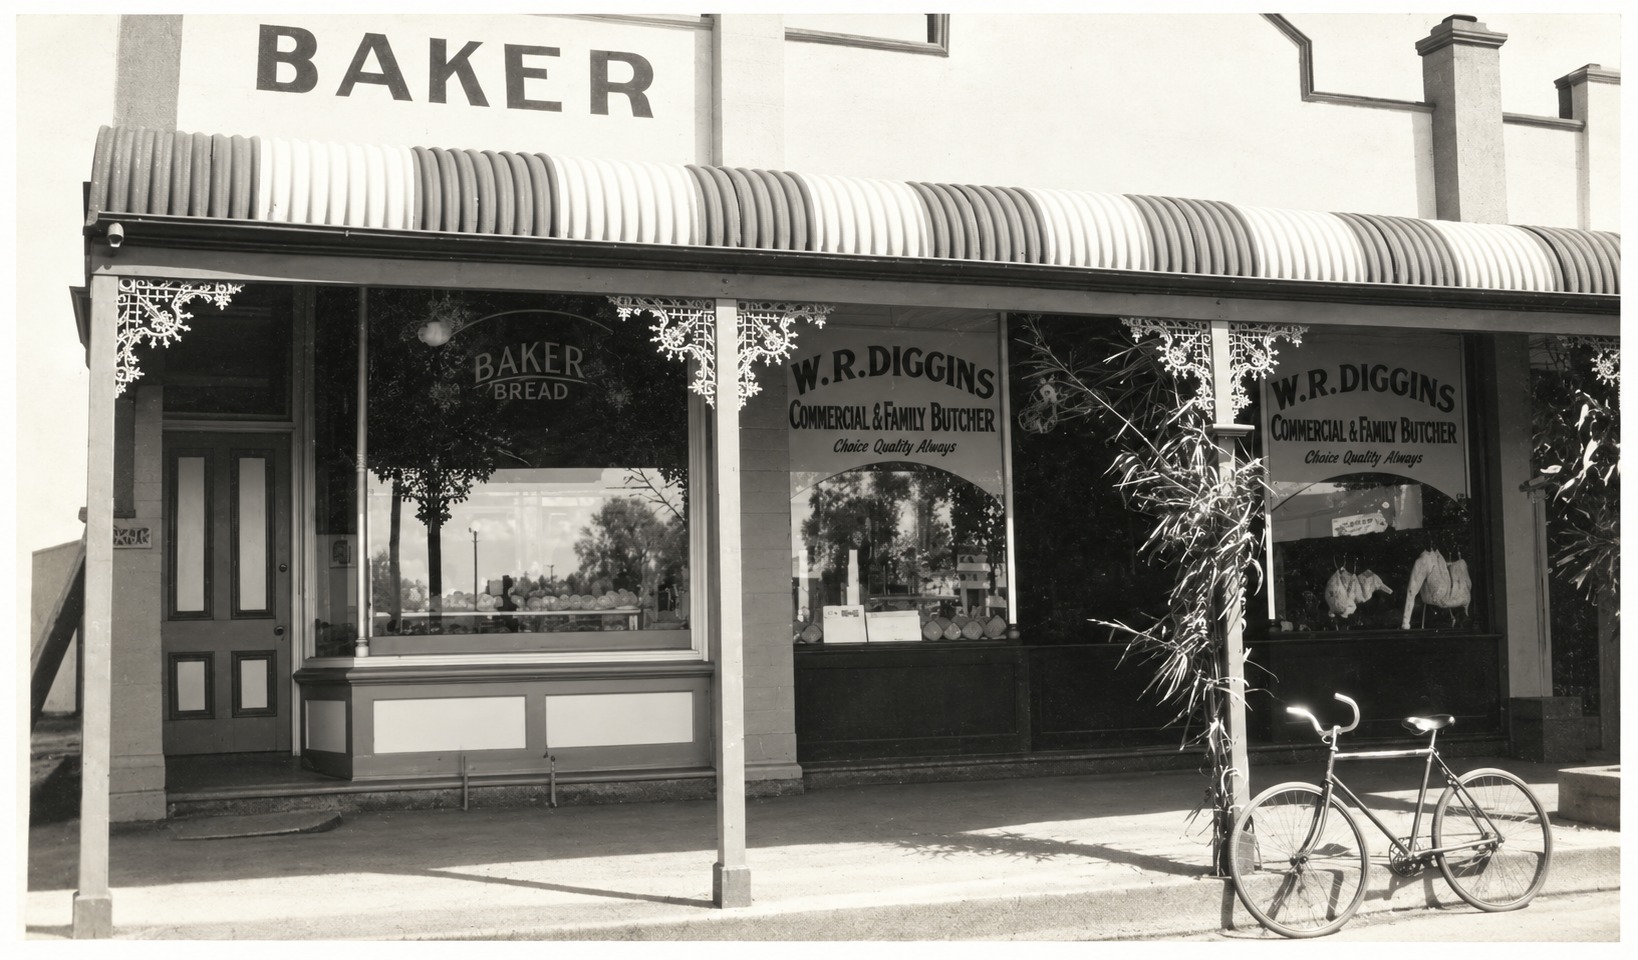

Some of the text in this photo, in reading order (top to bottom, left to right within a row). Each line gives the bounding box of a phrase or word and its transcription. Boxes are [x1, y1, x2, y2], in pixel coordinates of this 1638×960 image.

[256, 23, 654, 118] BAKER
[474, 341, 586, 384] BAKER
[494, 382, 568, 400] BREAD
[789, 399, 996, 433] COMMERCIAL & FAMILY BUTCHER
[1271, 413, 1458, 444] COMMERCIAL & FAMILY BUTCHER
[833, 438, 957, 457] Choice Quality Always
[1304, 450, 1423, 468] Choice Quality Always
